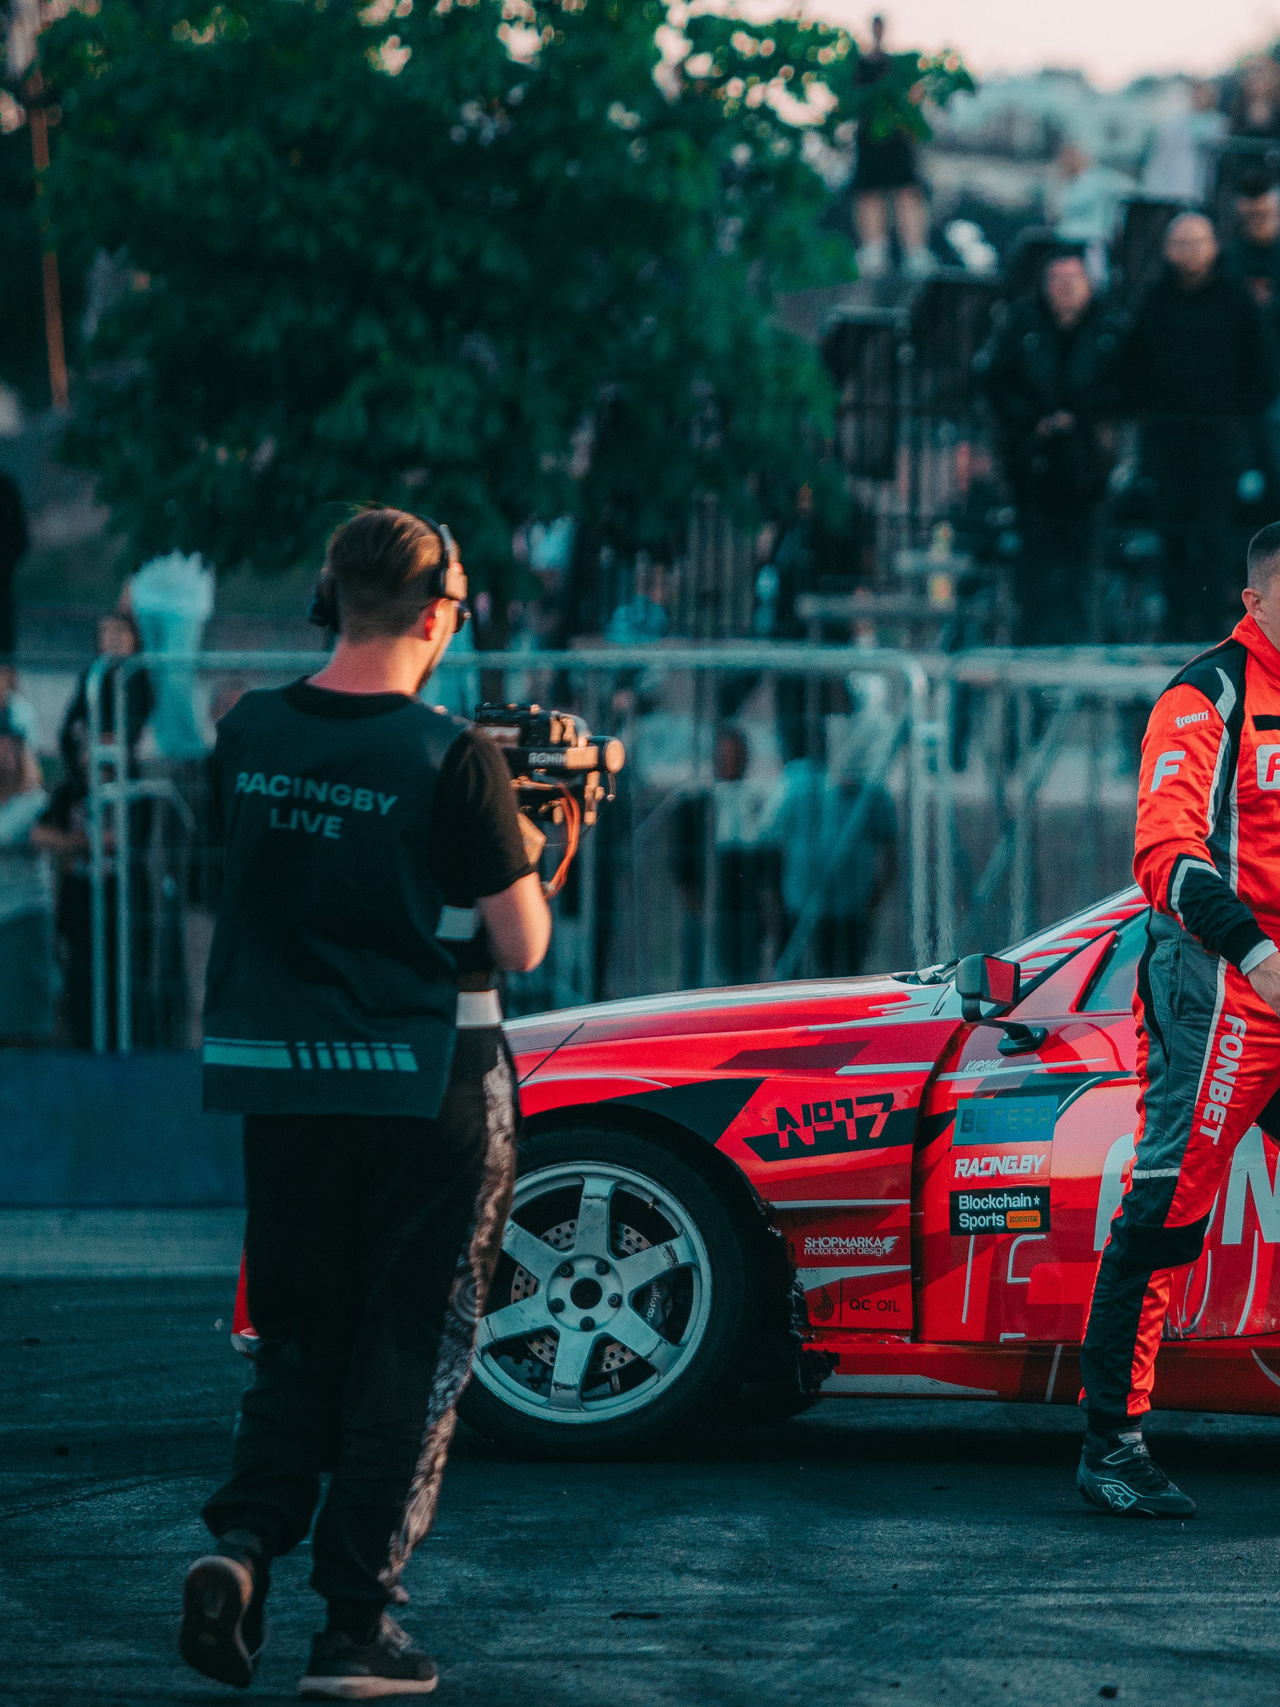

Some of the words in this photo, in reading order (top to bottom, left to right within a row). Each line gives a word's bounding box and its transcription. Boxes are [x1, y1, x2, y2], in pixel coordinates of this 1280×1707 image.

[270, 808, 343, 839] LIVE
[1199, 1013, 1247, 1146] FONBET
[954, 1154, 1046, 1178] RACING.BY
[958, 1193, 1032, 1210] Blockchain
[958, 1212, 1006, 1231] Sports
[804, 1236, 882, 1248] SHOPMARKA
[804, 1246, 855, 1256] motorsport
[849, 1299, 871, 1311] QC
[876, 1300, 901, 1312] OIL
